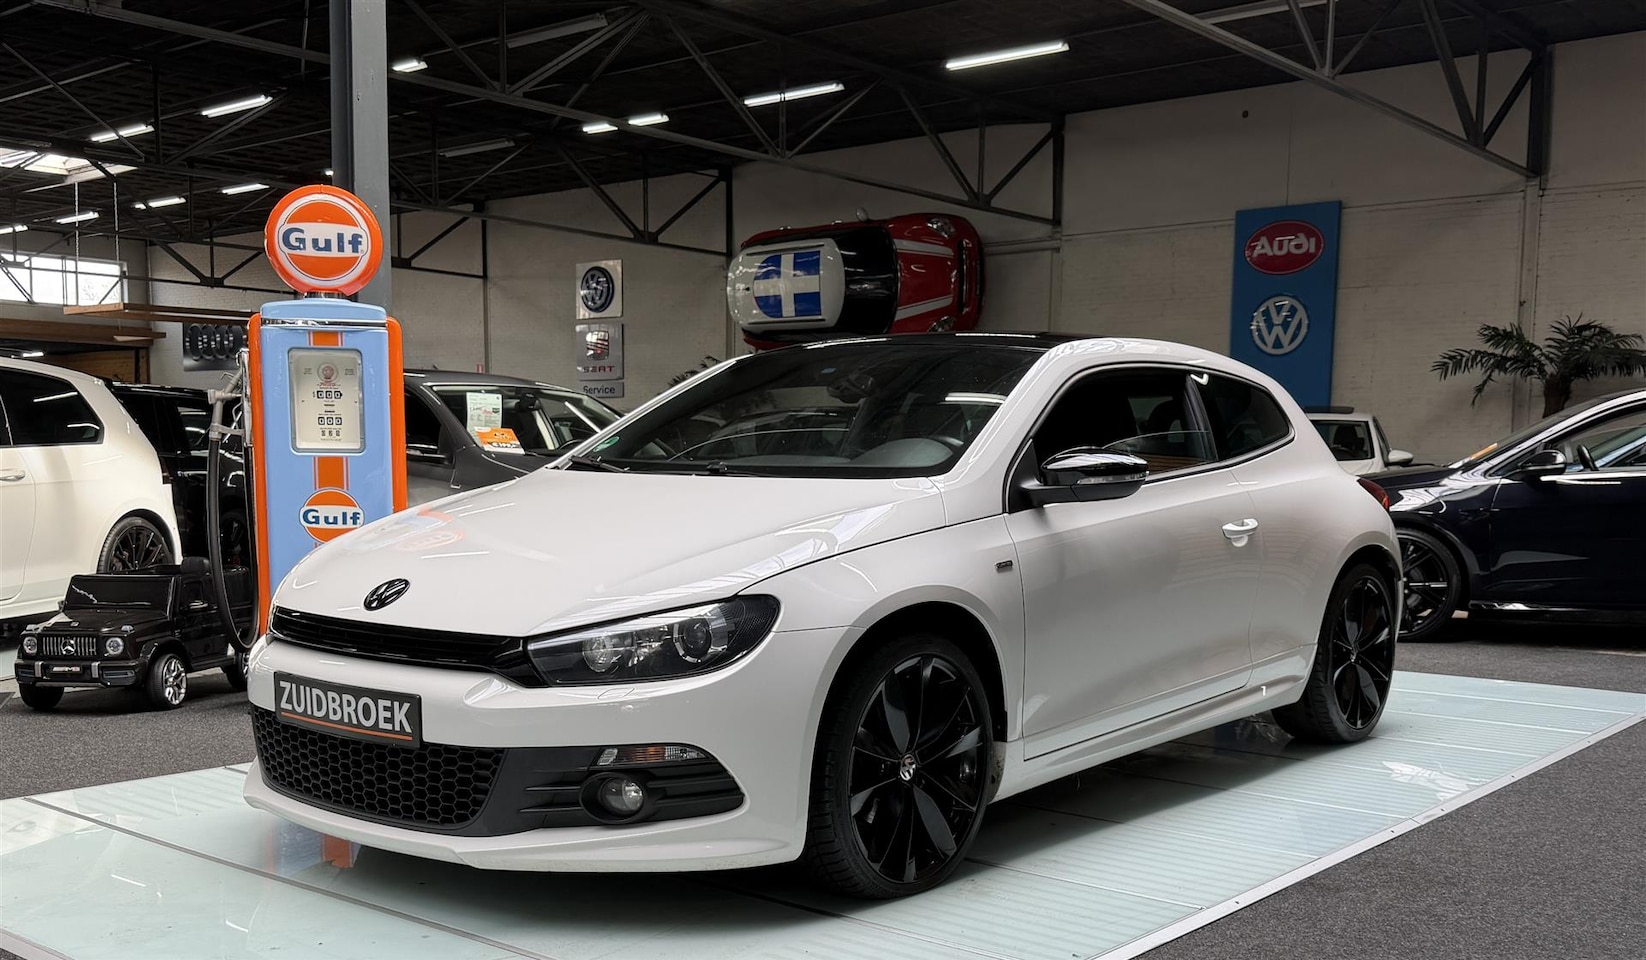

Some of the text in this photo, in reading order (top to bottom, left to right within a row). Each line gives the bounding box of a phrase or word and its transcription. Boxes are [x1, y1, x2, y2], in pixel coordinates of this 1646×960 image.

[282, 227, 363, 253] Gulf
[583, 365, 615, 373] SEAT
[583, 384, 616, 395] Service
[302, 508, 361, 526] Gulf
[279, 680, 413, 734] ZUIDBROEK
